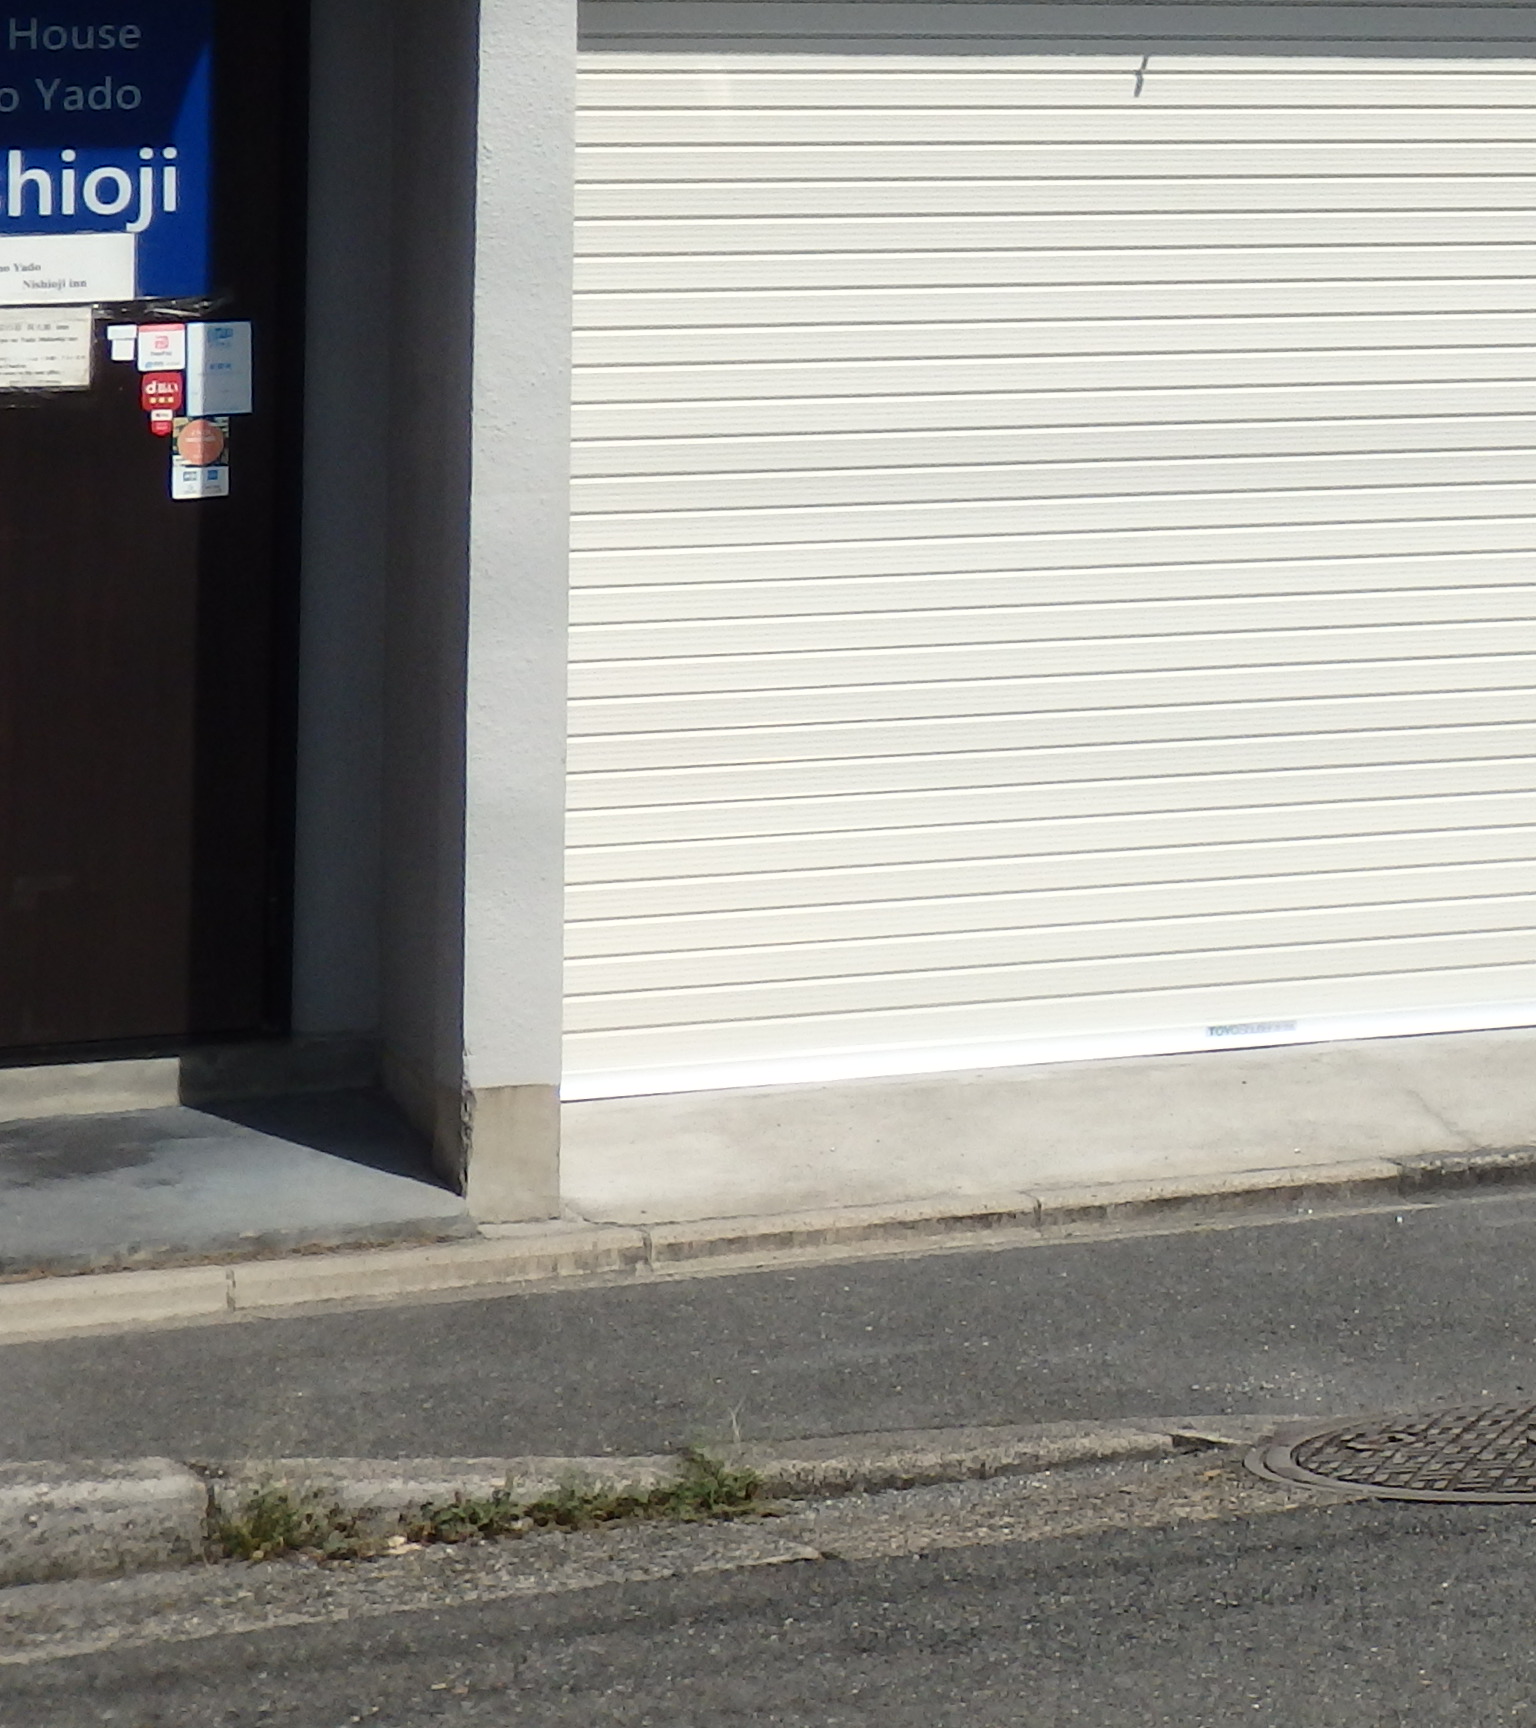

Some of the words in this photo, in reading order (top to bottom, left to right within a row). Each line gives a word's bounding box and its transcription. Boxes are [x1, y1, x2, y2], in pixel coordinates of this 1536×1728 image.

[8, 17, 142, 51] House
[34, 75, 143, 111] Yado
[0, 146, 178, 233] hioji
